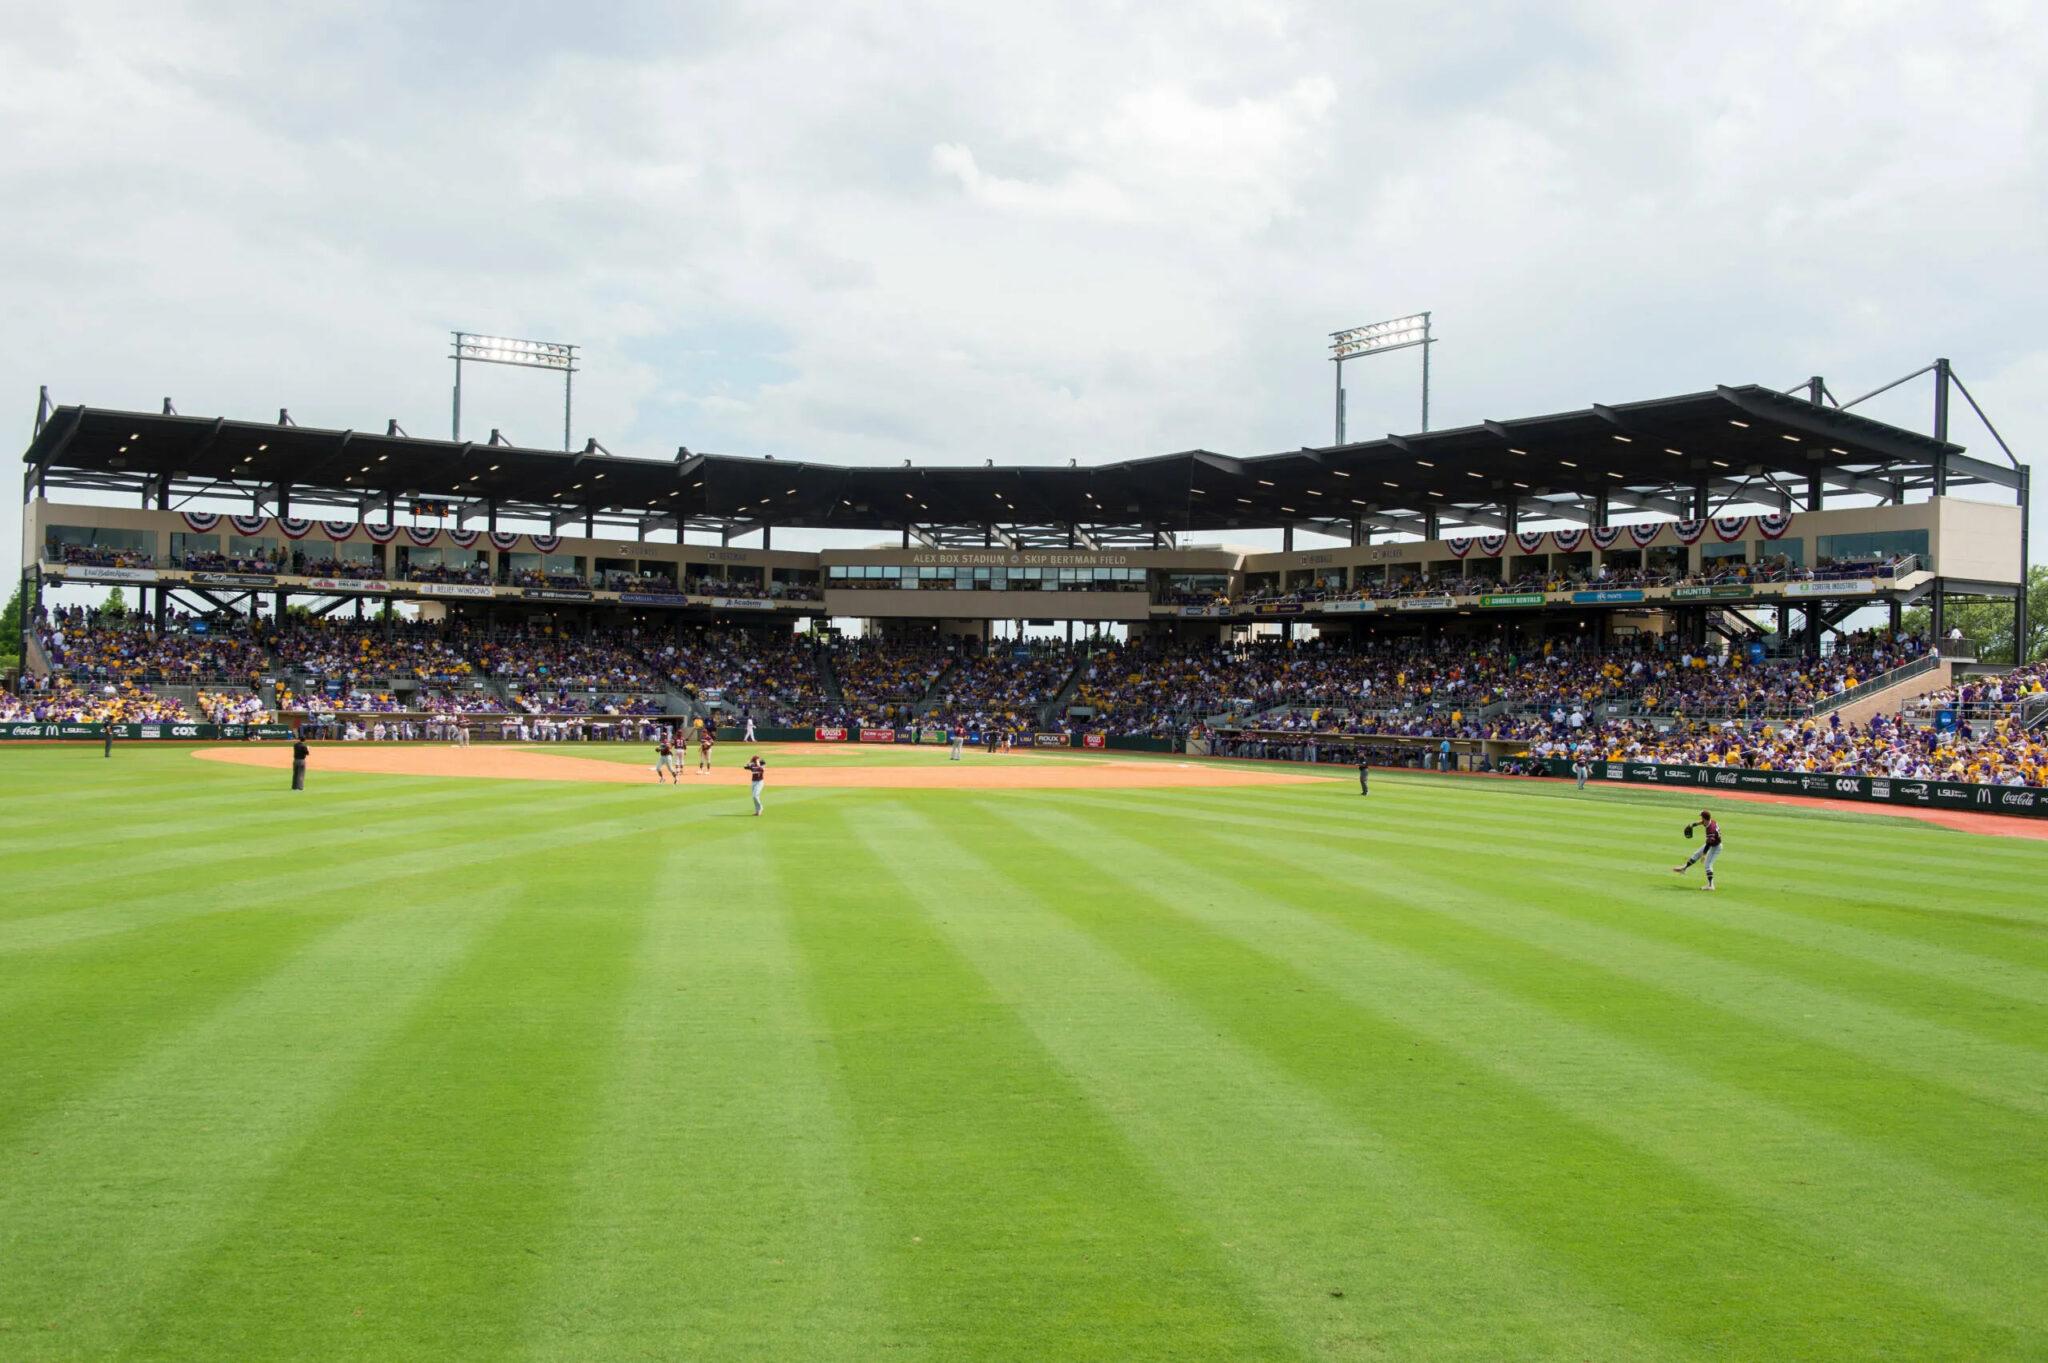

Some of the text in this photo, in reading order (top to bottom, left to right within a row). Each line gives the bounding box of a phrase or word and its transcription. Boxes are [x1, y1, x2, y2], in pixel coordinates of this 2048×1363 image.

[913, 554, 1005, 563] ALEX BOX STADIUM
[1024, 554, 1126, 564] SKIP BERTMAN FIELD
[456, 586, 490, 595] WINDOWS
[1683, 587, 1711, 595] HUNTER
[733, 599, 762, 607] Academy
[172, 726, 198, 736] COX
[1836, 778, 1860, 792] COX
[1937, 788, 1953, 797] LSU
